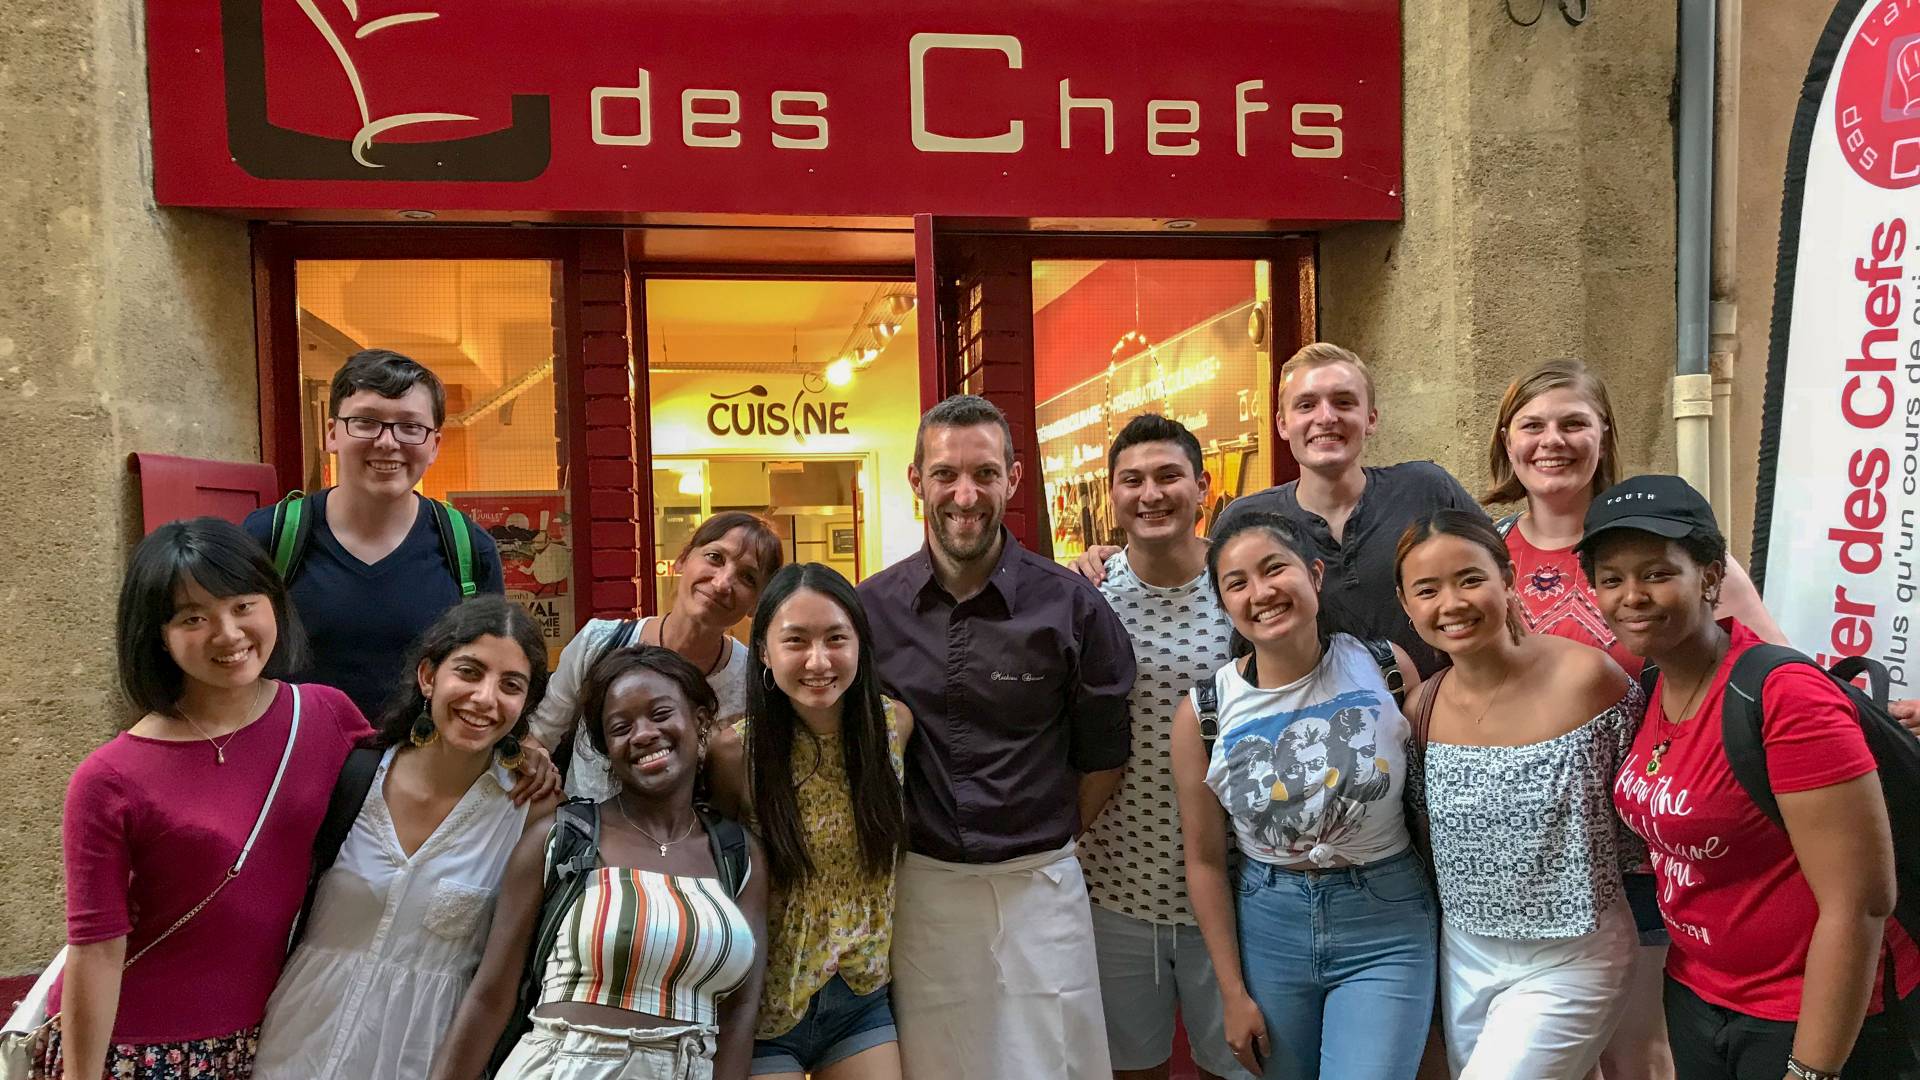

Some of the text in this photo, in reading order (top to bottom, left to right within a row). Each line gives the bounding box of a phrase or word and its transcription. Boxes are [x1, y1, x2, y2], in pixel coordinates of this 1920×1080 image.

[590, 32, 1344, 160] des Chefs
[1841, 217, 1908, 429] Chefs
[707, 390, 850, 443] CUISINE
[1902, 397, 1920, 495] cours
[1607, 492, 1655, 505] YOUTH
[1828, 447, 1891, 575] des
[1894, 509, 1918, 604] qu'un
[1883, 615, 1911, 687] plus
[1615, 754, 1693, 818] know the
